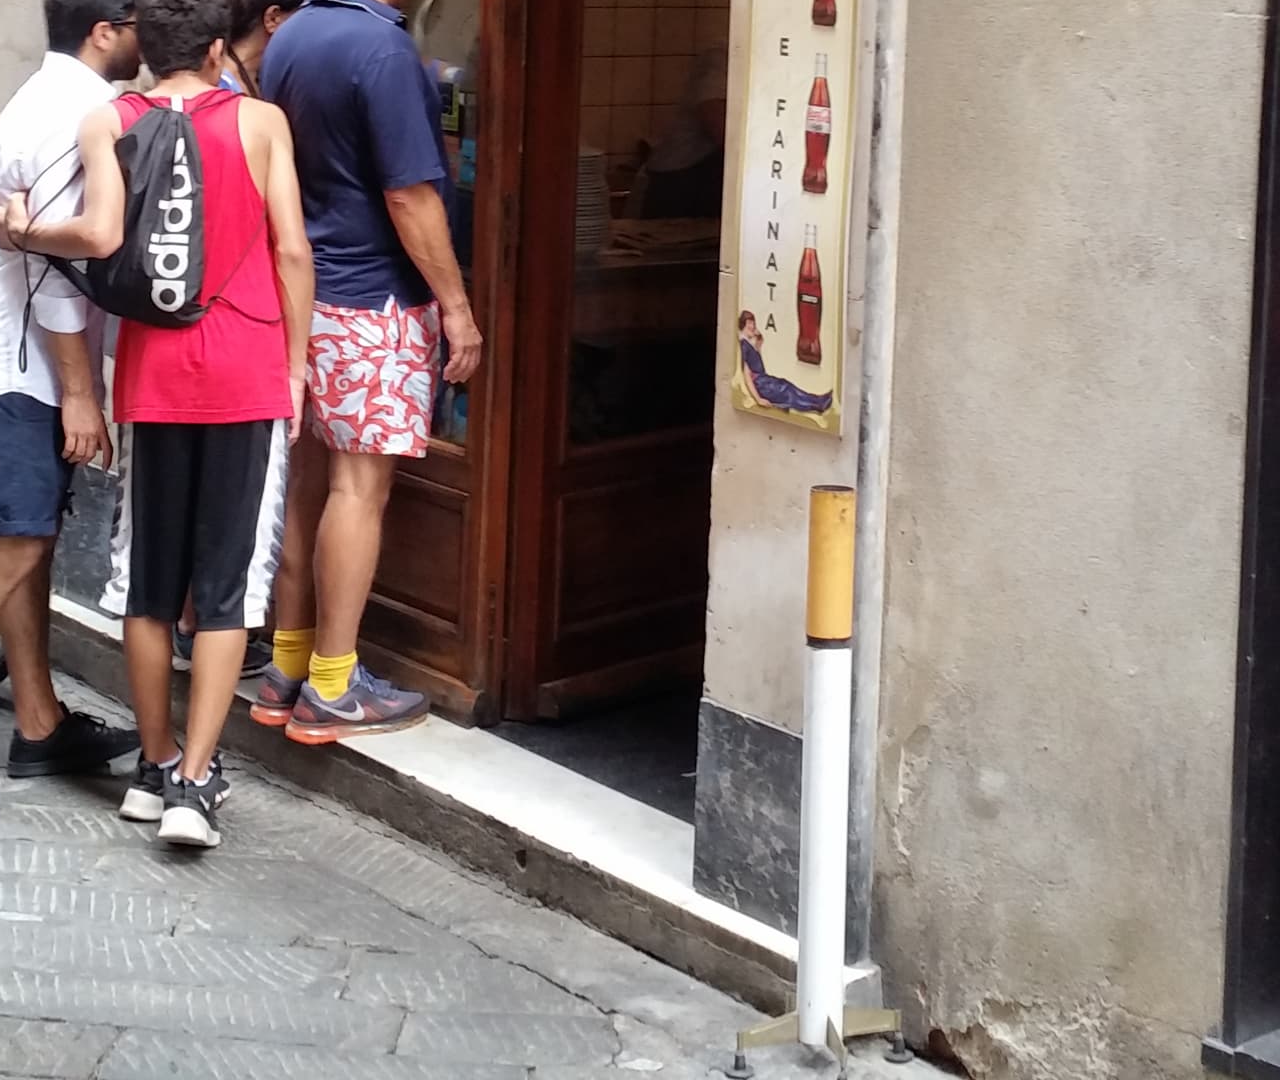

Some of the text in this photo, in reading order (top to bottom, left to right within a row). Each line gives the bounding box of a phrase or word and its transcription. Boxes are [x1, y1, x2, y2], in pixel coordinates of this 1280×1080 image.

[780, 37, 790, 57] E
[147, 137, 193, 313] adidas
[765, 98, 788, 334] FARINATA
